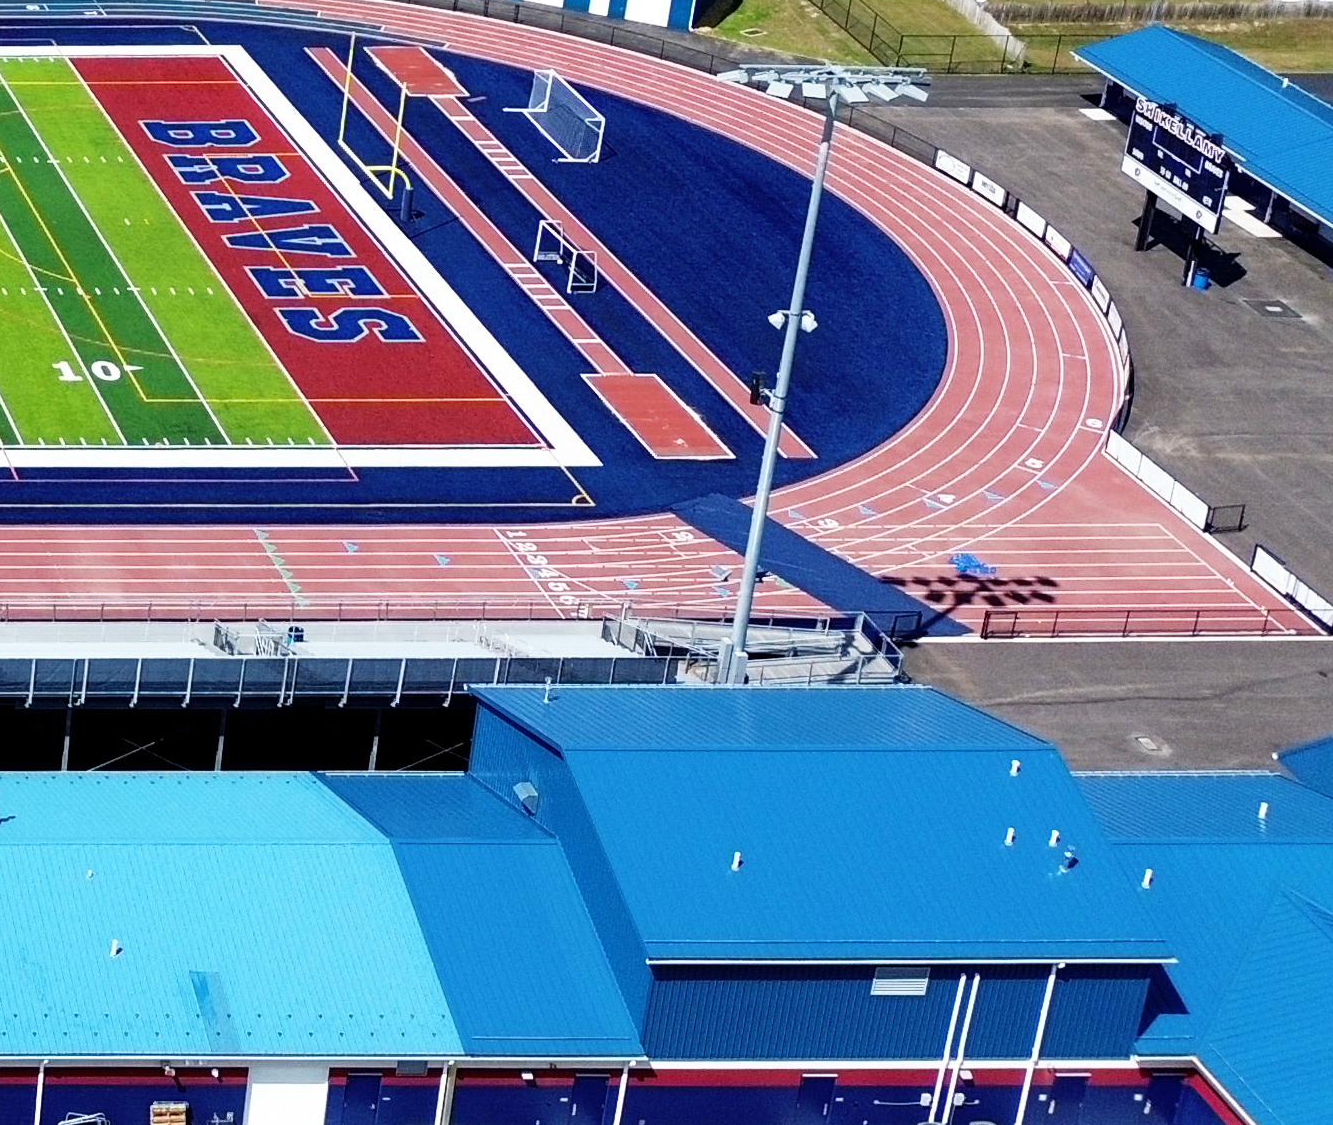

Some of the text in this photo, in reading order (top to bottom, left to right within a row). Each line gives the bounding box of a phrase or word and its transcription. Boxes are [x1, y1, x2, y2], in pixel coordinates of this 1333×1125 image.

[1136, 97, 1225, 164] SHIKELLAMY
[138, 119, 426, 342] BRAVES
[53, 360, 122, 382] 10
[505, 530, 527, 538] 1
[514, 542, 538, 552] 2
[527, 554, 549, 565] 3
[537, 568, 559, 578] 4
[548, 581, 571, 592] 5
